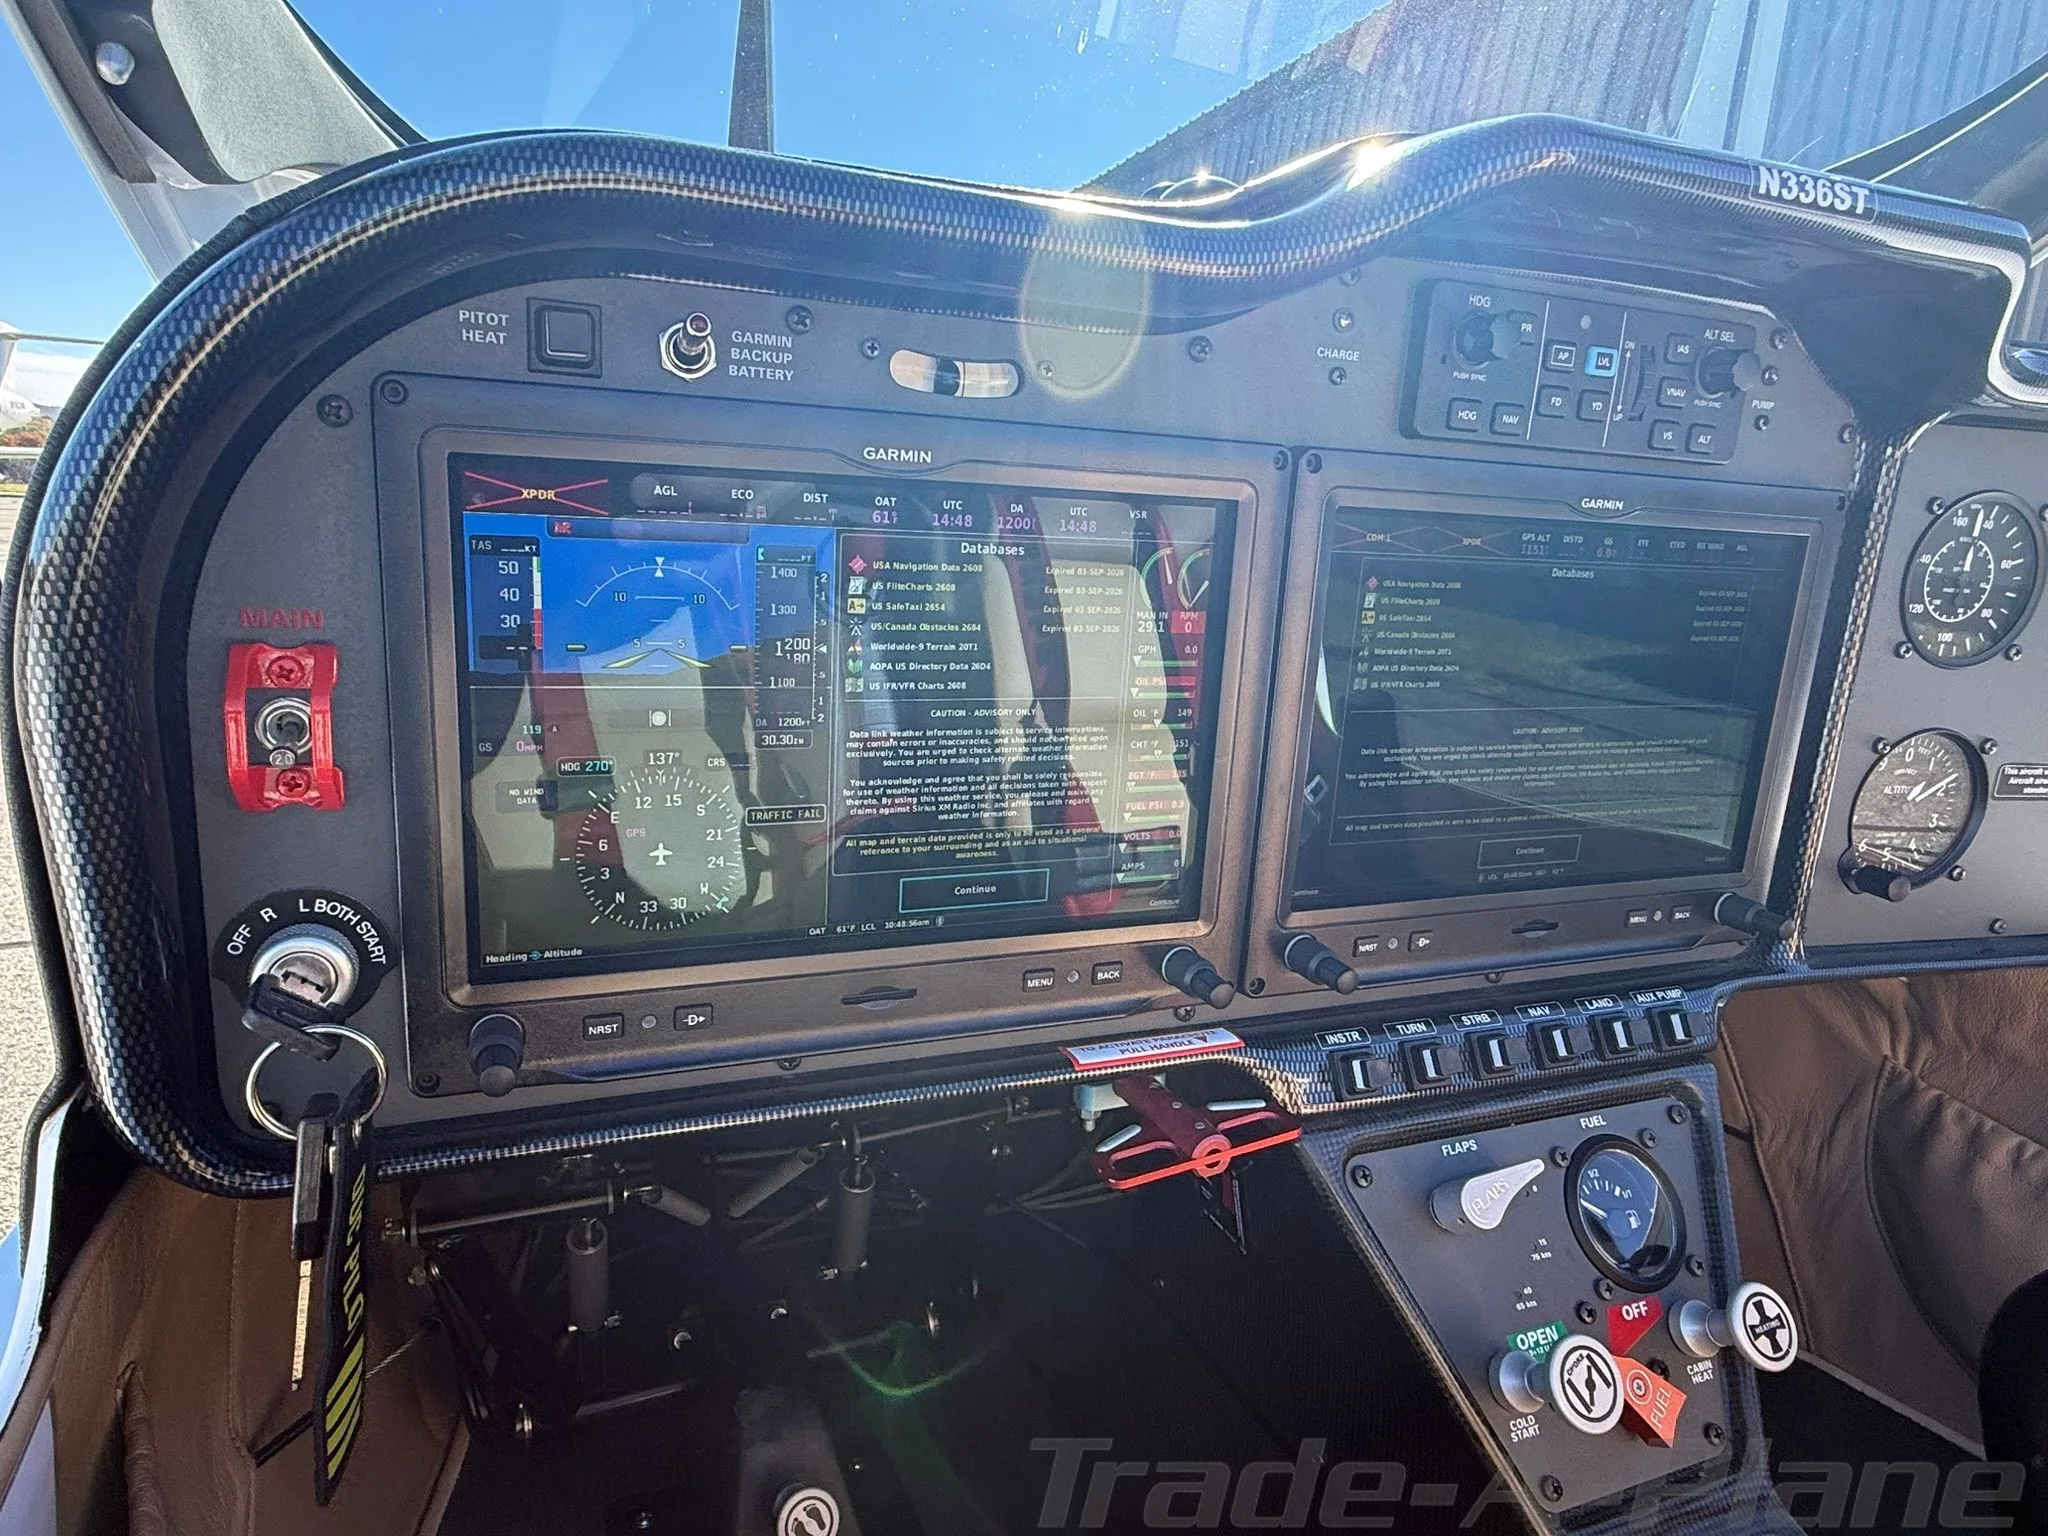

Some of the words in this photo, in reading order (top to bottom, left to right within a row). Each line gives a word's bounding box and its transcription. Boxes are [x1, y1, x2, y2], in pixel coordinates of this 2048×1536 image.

[1758, 166, 1870, 215] N336ST
[1469, 295, 1491, 308] HDG
[459, 310, 509, 328] PITOT
[1520, 323, 1532, 333] PR
[462, 328, 507, 345] HEAT
[731, 330, 792, 348] GARMIN
[1704, 329, 1719, 341] ALT
[1720, 330, 1735, 342] SEL
[1317, 347, 1360, 361] CHARGE
[1676, 344, 1689, 354] IAS
[731, 347, 793, 365] BACKUP
[1558, 350, 1569, 361] AP
[1597, 356, 1611, 367] LVL
[728, 364, 794, 382] BATTERY
[1666, 387, 1686, 398] VNAV
[1550, 397, 1562, 406] FD
[1591, 401, 1602, 411] YD
[1752, 399, 1774, 411] PUMP
[1458, 409, 1476, 421] HDG
[1502, 414, 1519, 425] NAV
[1663, 431, 1673, 441] VS
[1697, 434, 1711, 444] ALT
[863, 446, 932, 463] GARMIN
[520, 488, 557, 501] XPDR
[653, 485, 678, 497] AGL
[731, 489, 754, 501] ECO
[802, 493, 828, 505] DIST
[874, 496, 897, 508] OAT
[942, 499, 963, 511] UTC
[1581, 498, 1624, 511] GARMIN
[1010, 504, 1024, 514] DA
[1070, 507, 1088, 518] UTC
[1129, 510, 1147, 520] VSR
[931, 513, 973, 529] 14:48
[1059, 520, 1097, 534] 14:48
[1952, 515, 1969, 527] 160
[471, 540, 492, 551] TAS
[960, 542, 1025, 557] Databases
[499, 561, 519, 575] 50
[873, 562, 891, 572] USA
[893, 563, 938, 575] Navigation
[941, 564, 961, 573] Data
[2001, 560, 2013, 570] 60
[771, 567, 799, 579] 1400
[1551, 568, 1595, 580] Databases
[873, 582, 884, 591] US
[886, 582, 933, 592] FliteCharts
[500, 588, 520, 602] 40
[613, 591, 627, 602] 10
[692, 595, 706, 605] 10
[771, 604, 798, 617] 1300
[872, 602, 883, 611] US
[886, 602, 922, 612] SafeTaxi
[1908, 604, 1925, 615] 120
[240, 608, 326, 630] MAIN
[1981, 609, 1993, 619] 80
[501, 615, 520, 628] 30
[871, 622, 918, 633] US/Canada
[920, 622, 960, 632] Obstacles
[1937, 632, 1954, 643] 100
[870, 642, 924, 652] Worldwide-9
[925, 643, 957, 652] Terrain
[1138, 645, 1156, 654] GPH
[869, 662, 893, 671] AOPA
[895, 662, 907, 671] US
[909, 661, 949, 673] Directory
[950, 662, 970, 671] Data
[770, 676, 796, 689] 1100
[869, 682, 881, 691] US
[883, 681, 915, 691] IFR/VFR
[917, 681, 945, 690] Charts
[930, 709, 966, 718] CAUTION
[973, 708, 1013, 718] ADVISORY
[1015, 707, 1036, 717] ONLY
[849, 729, 870, 739] Data
[871, 729, 888, 739] link
[889, 728, 924, 739] weather
[926, 727, 974, 737] information
[984, 726, 1014, 738] subject
[478, 742, 494, 752] GS
[648, 751, 681, 765] 137°
[707, 756, 726, 767] CRS
[1905, 748, 1914, 763] 0
[560, 762, 580, 772] HDG
[585, 760, 614, 772] 270°
[850, 779, 867, 789] You
[868, 777, 922, 789] acknowledge
[523, 787, 544, 797] WIND
[516, 797, 538, 805] DATA
[635, 797, 652, 810] 12
[665, 795, 683, 807] 15
[696, 804, 706, 817] S
[751, 810, 794, 821] TRAFFIC
[798, 808, 822, 820] FAIL
[610, 811, 620, 824] E
[1928, 813, 1939, 828] 3
[626, 827, 647, 838] GPS
[706, 830, 724, 841] 21
[1123, 831, 1151, 841] VOLTS
[598, 839, 608, 852] 6
[1858, 838, 1868, 852] 6
[708, 857, 725, 869] 24
[1121, 861, 1146, 871] AMPS
[600, 868, 609, 879] 3
[700, 883, 709, 895] W
[955, 884, 997, 896] Continue
[615, 892, 625, 904] N
[669, 898, 687, 910] 30
[299, 898, 311, 913] L
[314, 898, 361, 926] BOTH
[640, 901, 658, 913] 33
[260, 907, 278, 923] R
[809, 927, 826, 936] OAT
[861, 923, 877, 932] LCL
[226, 923, 254, 956] OFF
[356, 920, 387, 965] START
[1359, 942, 1379, 953] NRST
[486, 952, 528, 965] Heading
[544, 948, 583, 960] Altitude
[1096, 970, 1121, 981] BACK
[1027, 977, 1054, 988] MENU
[1636, 991, 1656, 1005] AUX
[1656, 987, 1682, 1002] PUMP
[1584, 997, 1614, 1011] LAND
[1529, 1004, 1551, 1019] NAV
[1461, 1013, 1492, 1029] STRB
[588, 1023, 619, 1036] NRST
[1395, 1022, 1427, 1038] TURN
[1324, 1029, 1363, 1048] INSTR
[1119, 1044, 1150, 1057] PULL
[1151, 1038, 1196, 1053] HANDLE
[1580, 1115, 1606, 1130] FUEL
[1441, 1139, 1478, 1157] FLAPS
[1621, 1300, 1649, 1321] OFF
[1516, 1325, 1559, 1350] OPEN
[1566, 1352, 1586, 1377] CHOKE
[1686, 1359, 1713, 1375] CABIN
[1691, 1369, 1713, 1384] HEAT
[1509, 1415, 1536, 1433] COLD
[1511, 1426, 1541, 1443] START
